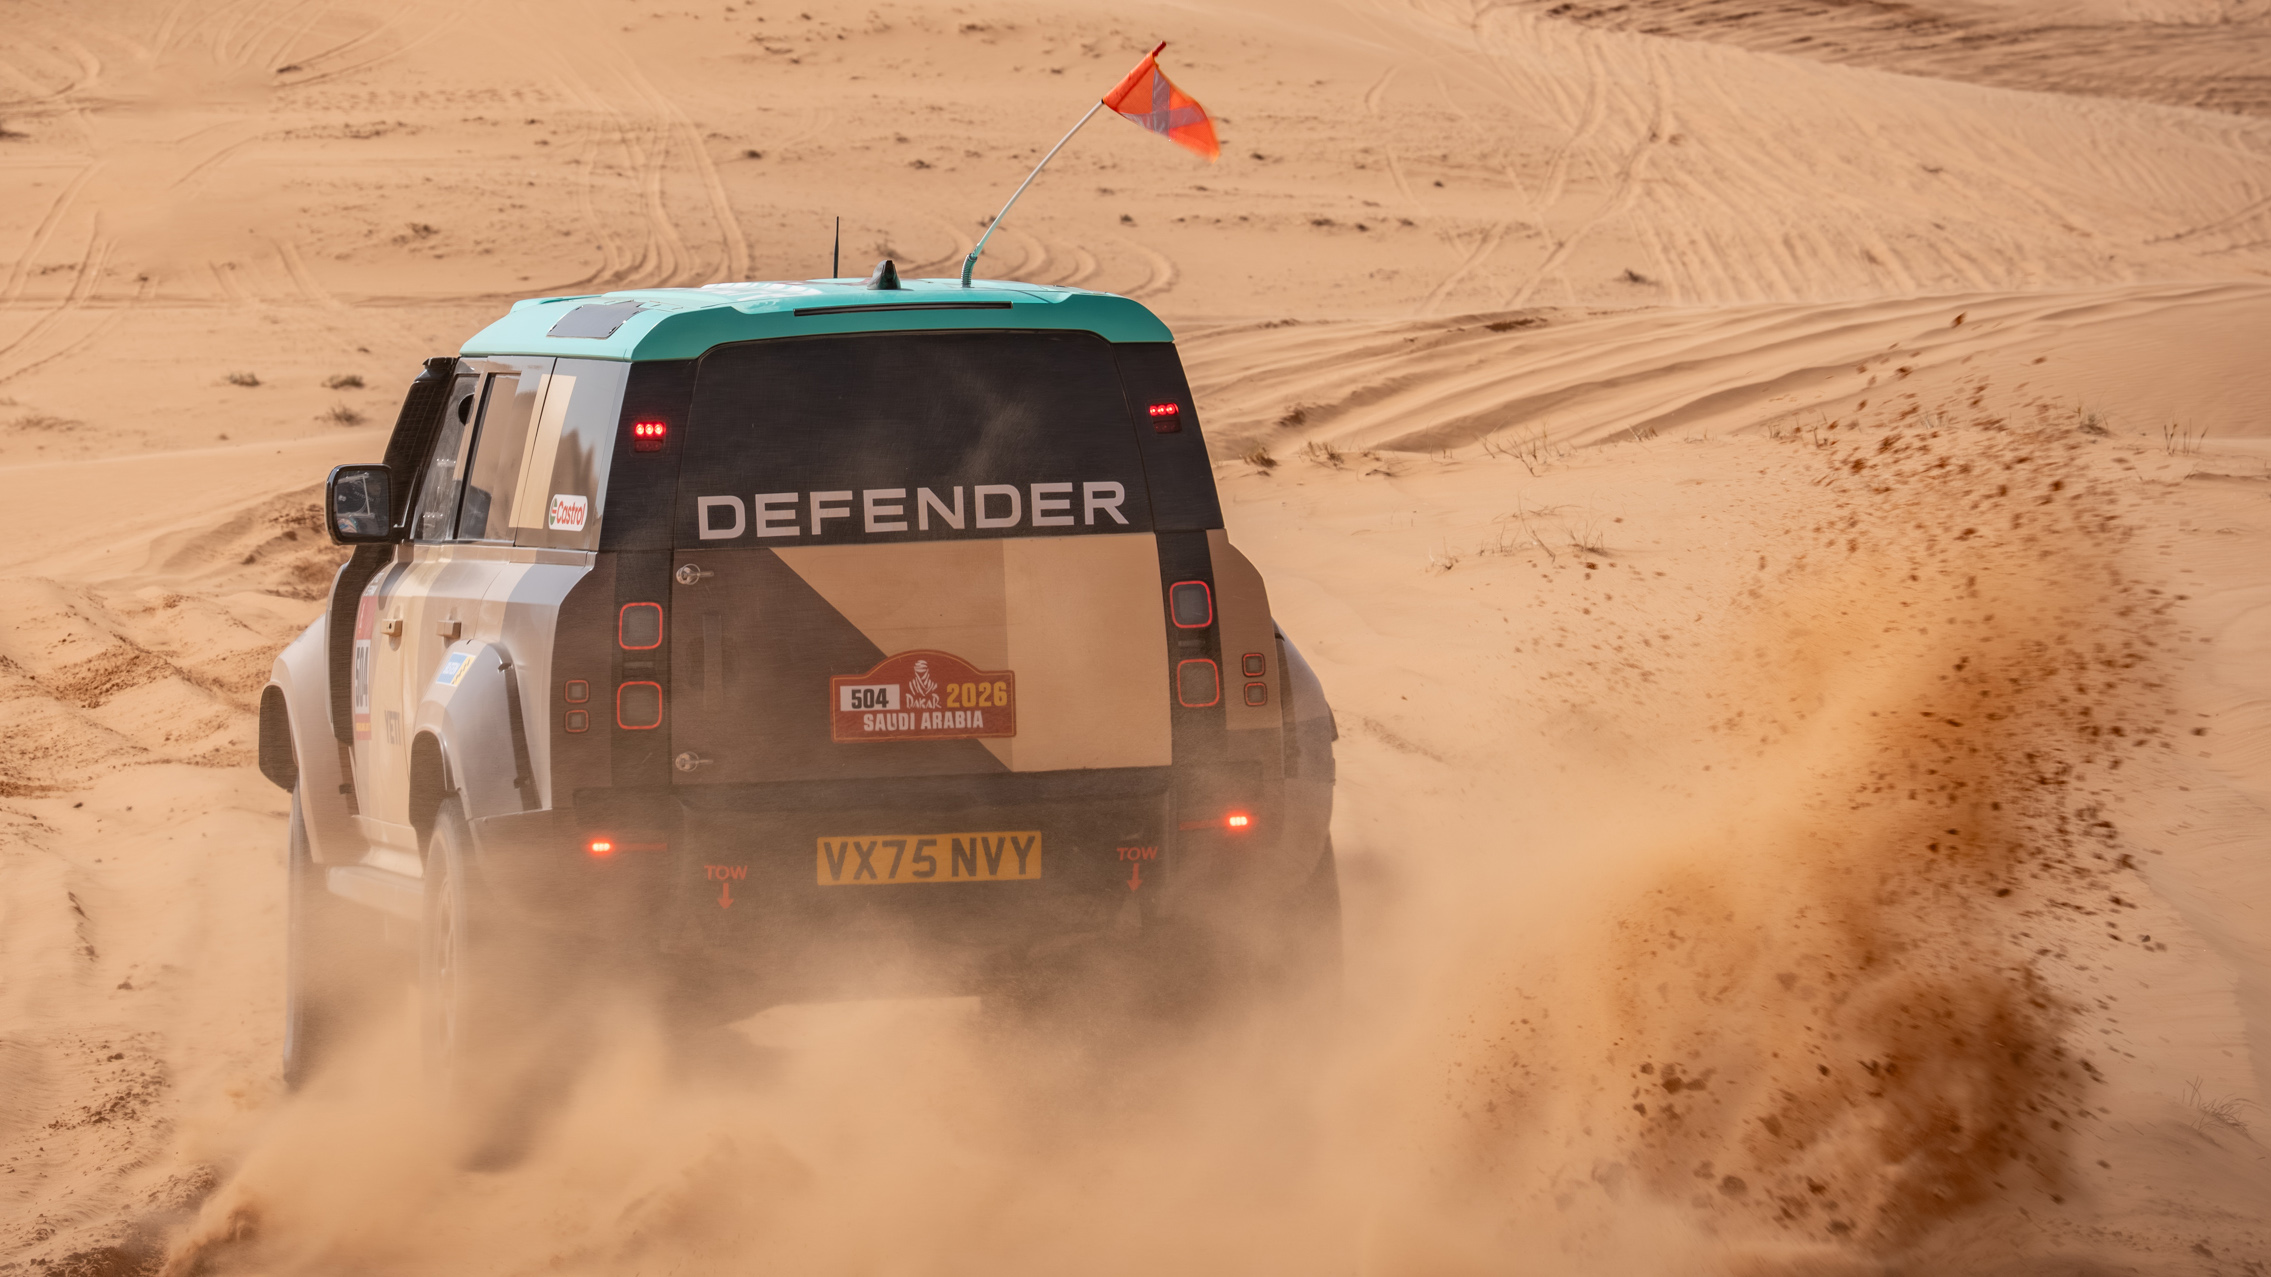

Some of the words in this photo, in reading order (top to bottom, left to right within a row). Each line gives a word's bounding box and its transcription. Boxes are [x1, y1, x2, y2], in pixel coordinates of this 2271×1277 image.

[556, 500, 586, 526] Castrol
[698, 481, 1130, 540] DEFENDER
[851, 687, 889, 709] 504
[905, 693, 942, 709] DAKAR
[946, 681, 1008, 708] 2026
[384, 709, 402, 746] YETI
[863, 712, 915, 732] SAUDI
[920, 710, 984, 730] ARABIA
[823, 838, 938, 882] VX75
[951, 835, 1036, 877] NVY
[1116, 846, 1159, 861] TOW
[703, 864, 748, 880] TOW
